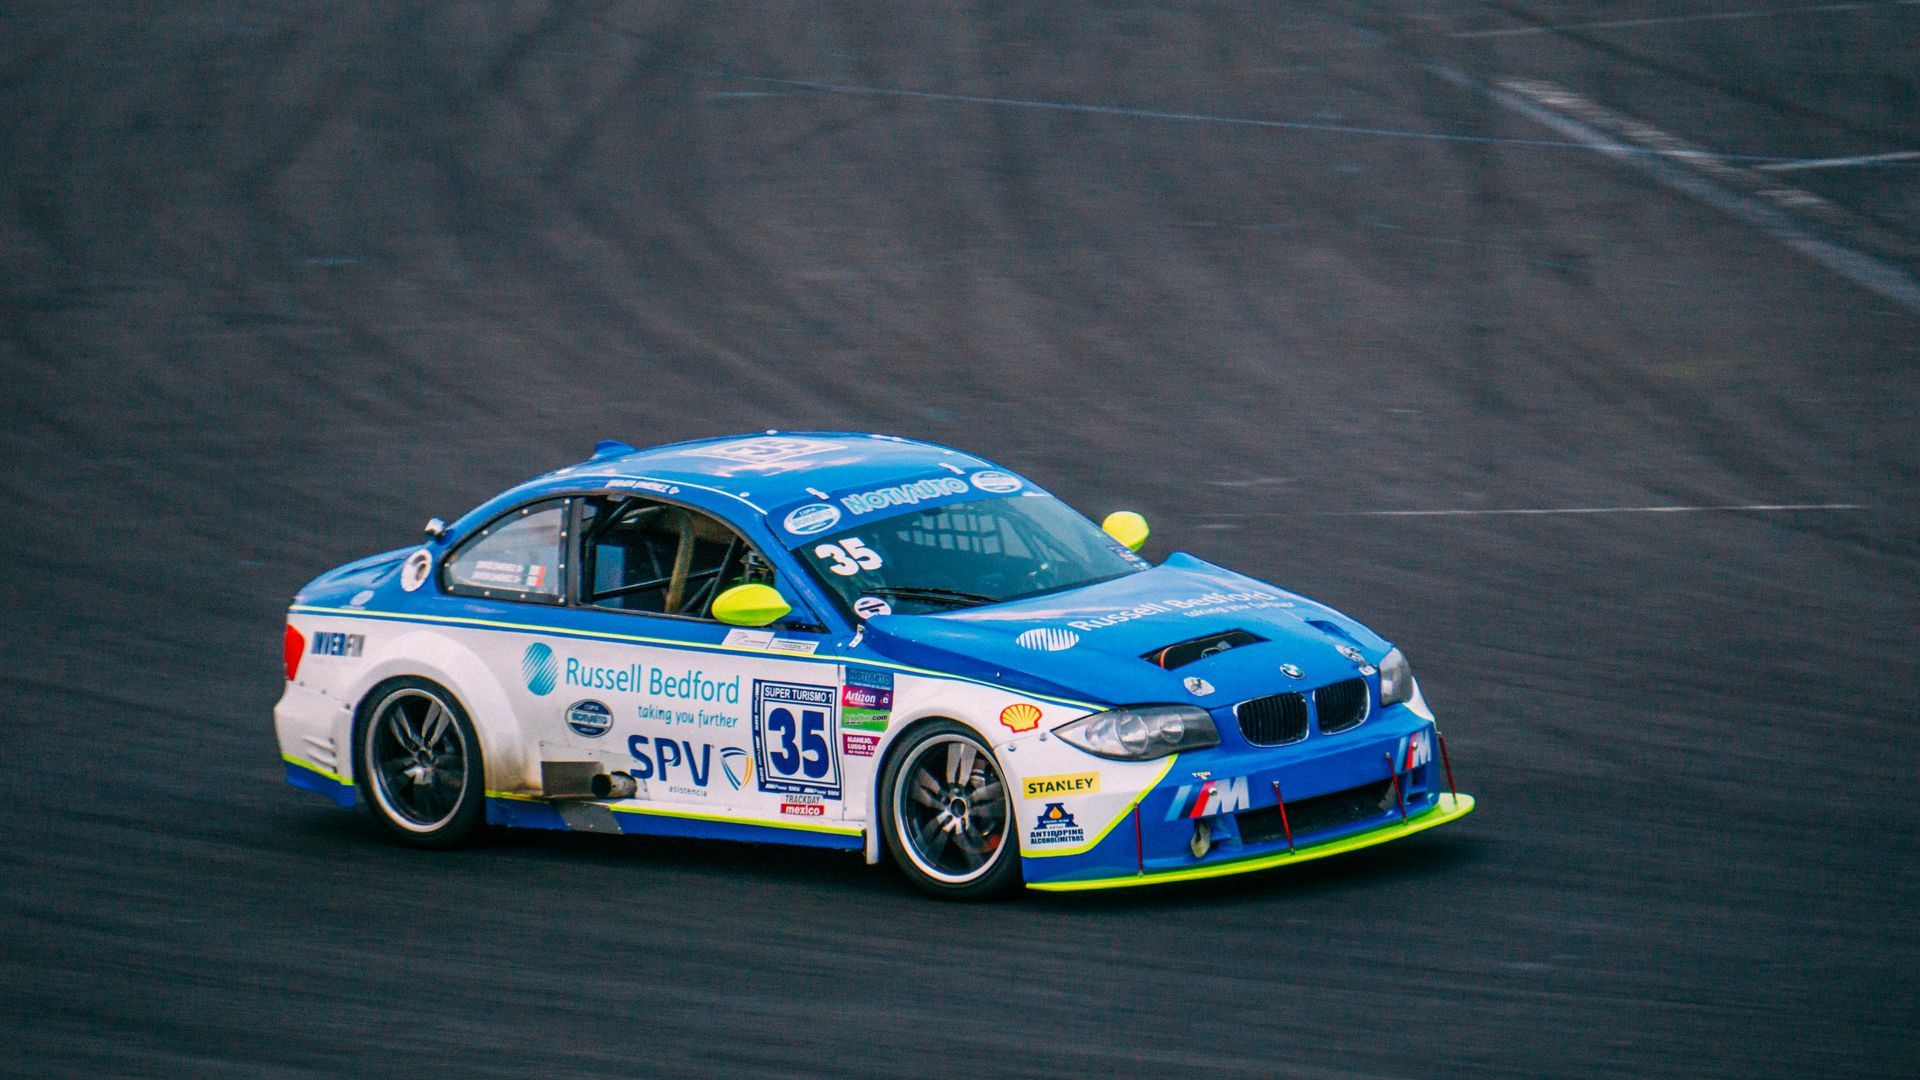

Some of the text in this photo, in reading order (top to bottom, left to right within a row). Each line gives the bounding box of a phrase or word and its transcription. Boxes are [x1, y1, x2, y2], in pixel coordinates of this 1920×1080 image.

[840, 477, 969, 515] NOTIAUTO
[814, 537, 883, 577] 35
[1067, 590, 1278, 631] Russell Bedford
[566, 657, 740, 704] Russell Bedford
[764, 686, 833, 703] SUPER TURISMO 1
[845, 690, 876, 703] Artizon
[638, 704, 738, 728] taking you further
[767, 707, 830, 779] 35
[627, 734, 711, 787] SPV
[668, 785, 708, 797] asistencia
[1028, 778, 1094, 794] STANLEY
[785, 794, 821, 805] TRACKDAY
[785, 805, 820, 816] mexico
[1030, 828, 1084, 838] ANTIDOPING
